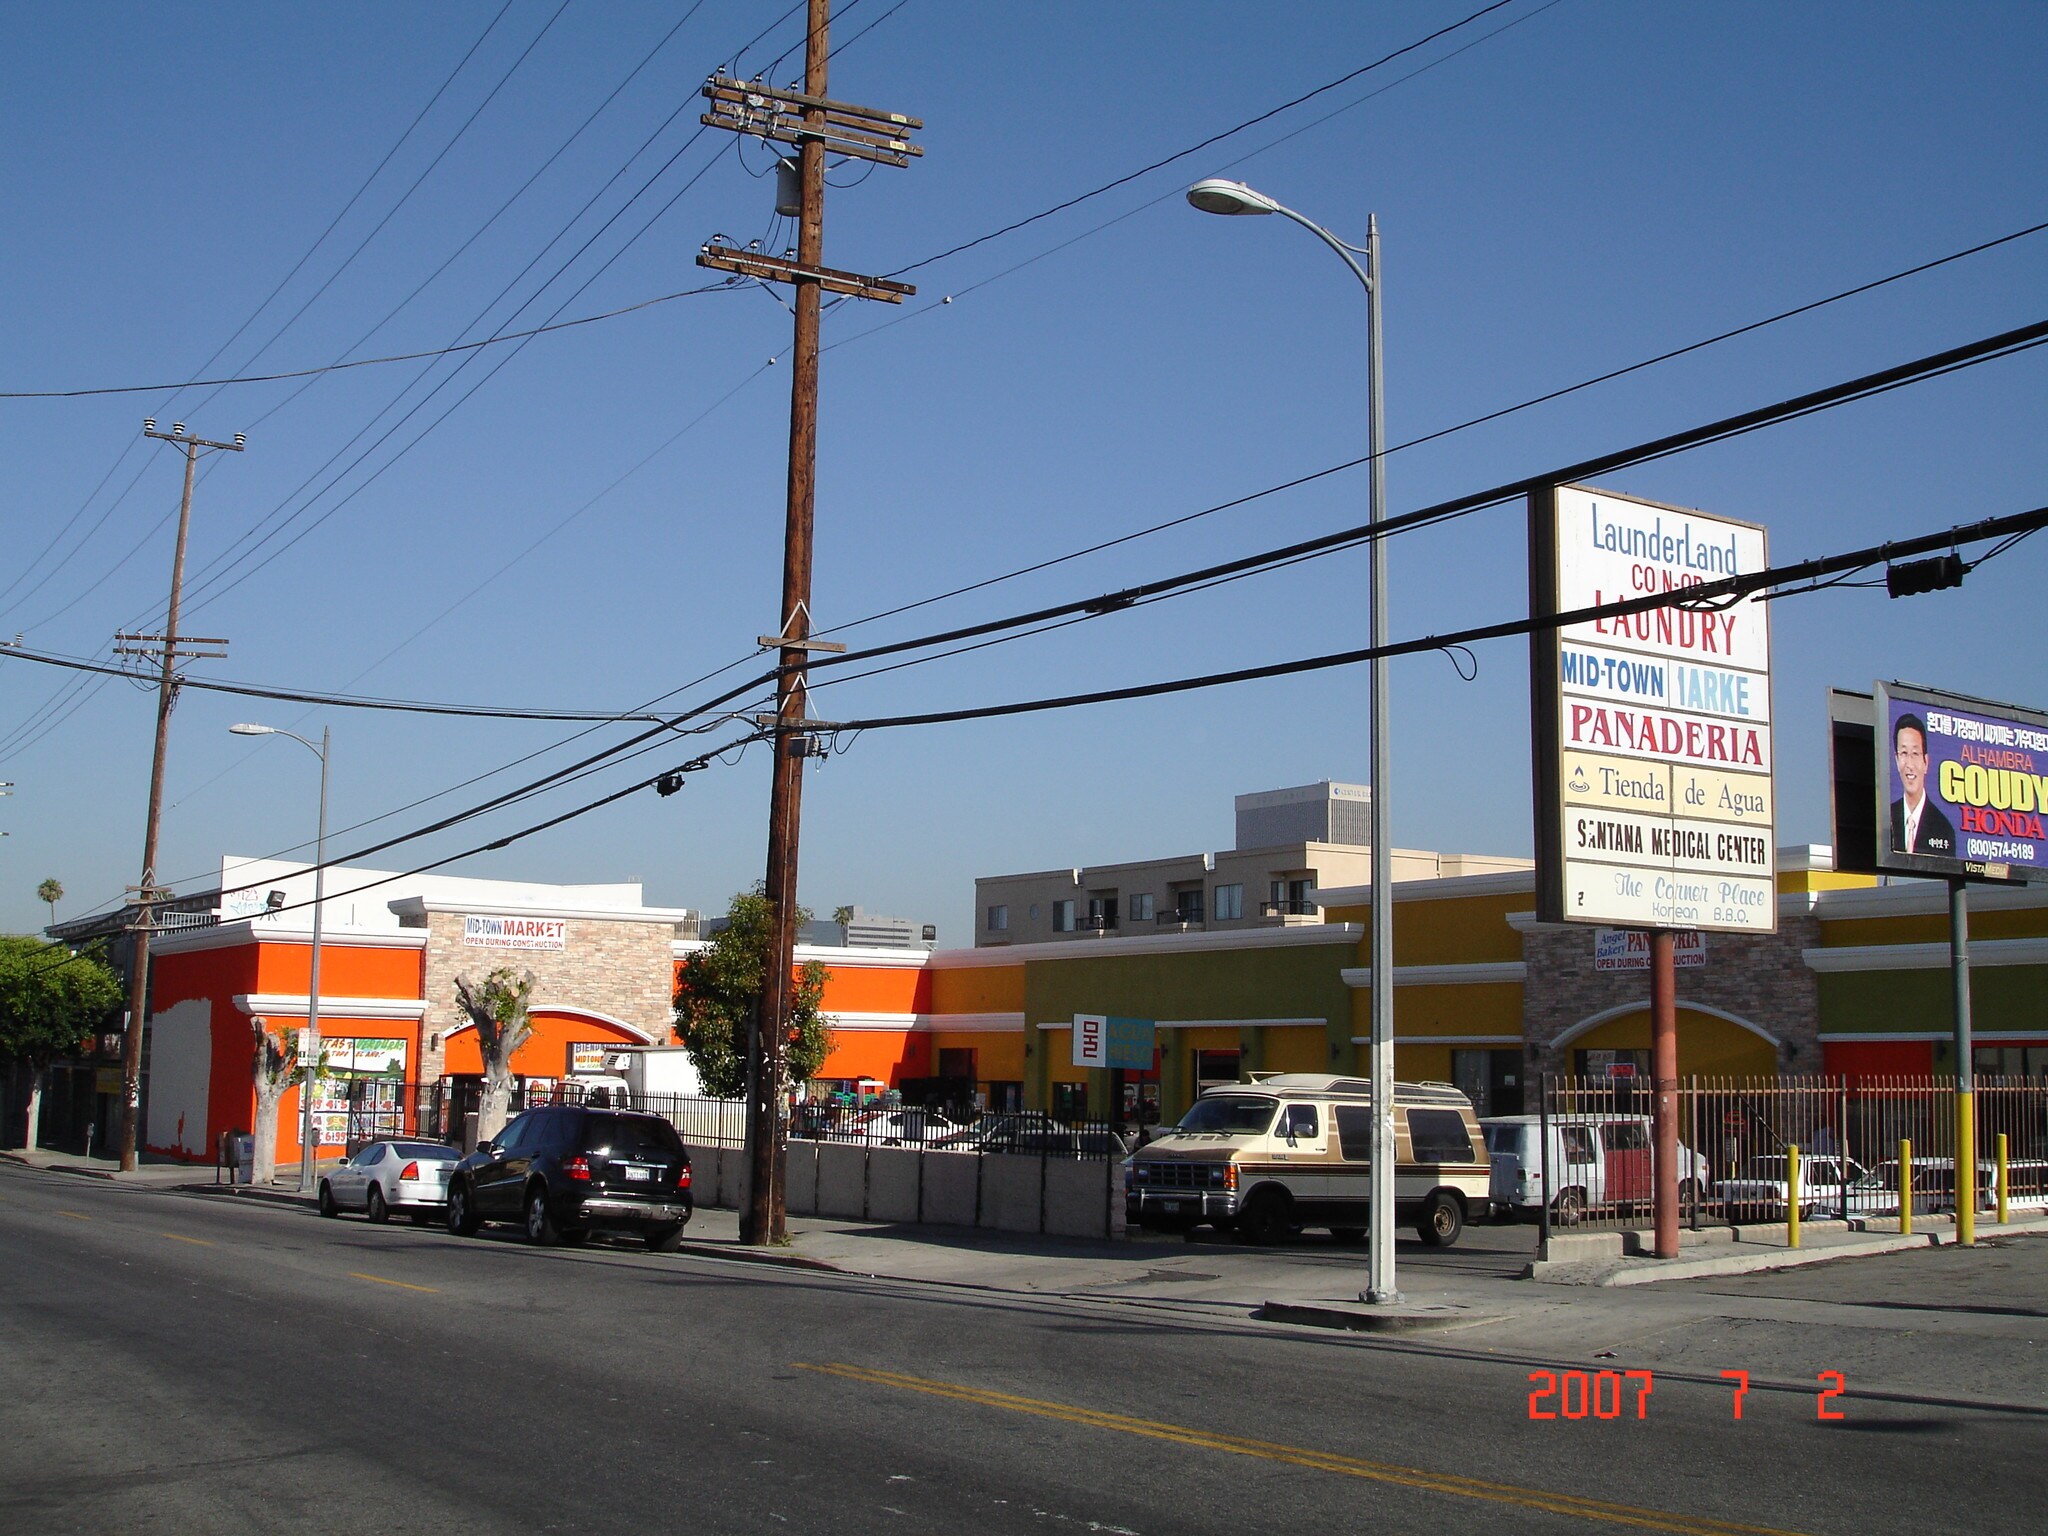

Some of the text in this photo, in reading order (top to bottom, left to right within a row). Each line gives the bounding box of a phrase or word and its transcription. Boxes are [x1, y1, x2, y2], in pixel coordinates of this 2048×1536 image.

[1592, 502, 1737, 576] LaunderLand
[1596, 589, 1736, 656] LAUNDRY
[1562, 651, 1664, 698] MID-TOWN
[1571, 704, 1764, 766] PANADERIA
[1960, 744, 2034, 772] ALHAMBRA
[1599, 767, 1765, 816] Tienda de Agua
[1939, 759, 2048, 815] GOUDY
[1960, 806, 2045, 840] HONDA
[1651, 826, 1711, 860] MEDICAL
[1717, 833, 1766, 865] CENTER
[1967, 838, 2034, 860] (800)574-6189
[1614, 872, 1765, 906] The Corner Place
[1652, 902, 1699, 920] Korean
[465, 937, 484, 946] OPEN
[485, 939, 511, 947] DURING
[503, 920, 564, 938] MARKET
[1596, 958, 1617, 969] OPEN
[1617, 957, 1645, 968] DURING
